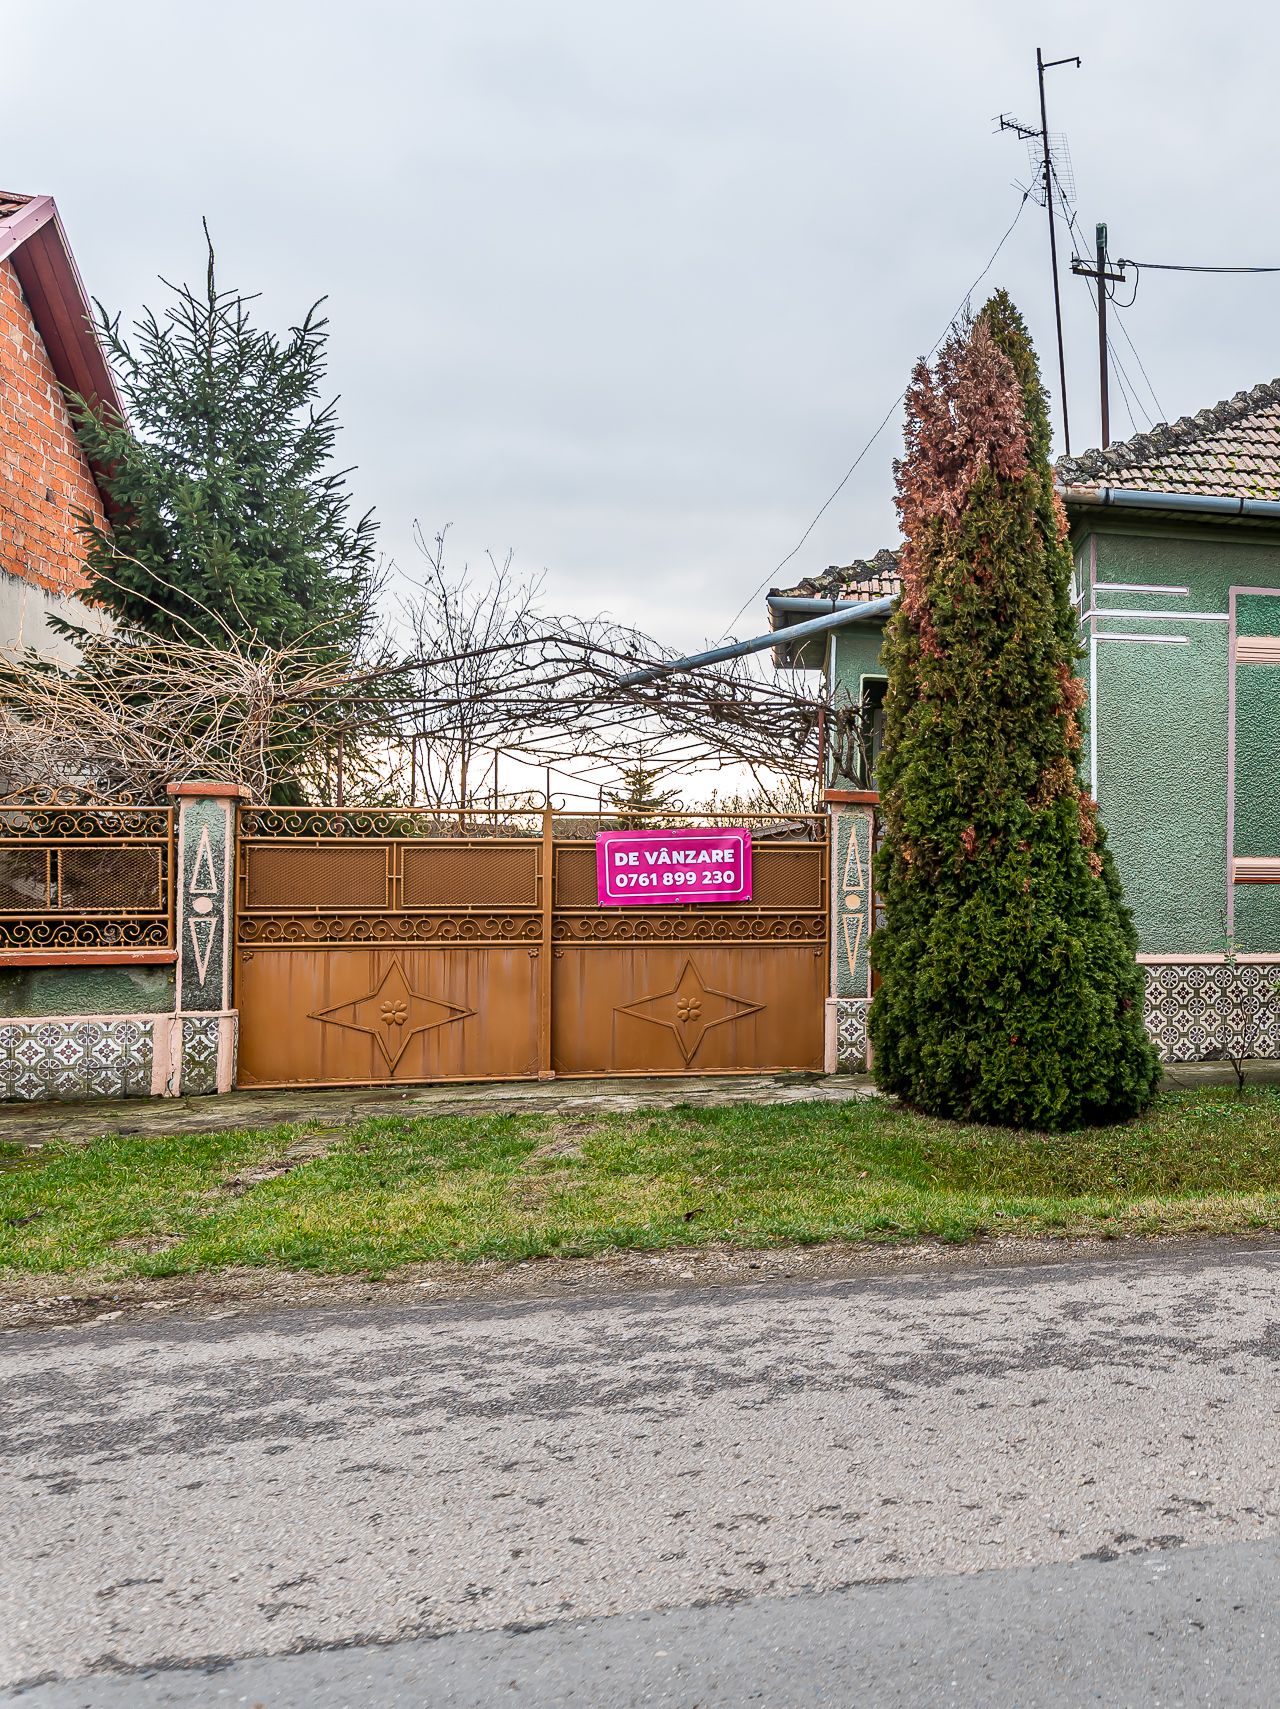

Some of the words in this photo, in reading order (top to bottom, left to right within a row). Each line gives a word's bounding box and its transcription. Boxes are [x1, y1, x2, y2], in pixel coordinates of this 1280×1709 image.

[614, 852, 639, 866] DE
[644, 847, 734, 865] VÂNZARE
[615, 873, 658, 887] 0761
[662, 871, 697, 885] 899
[701, 870, 735, 884] 230
